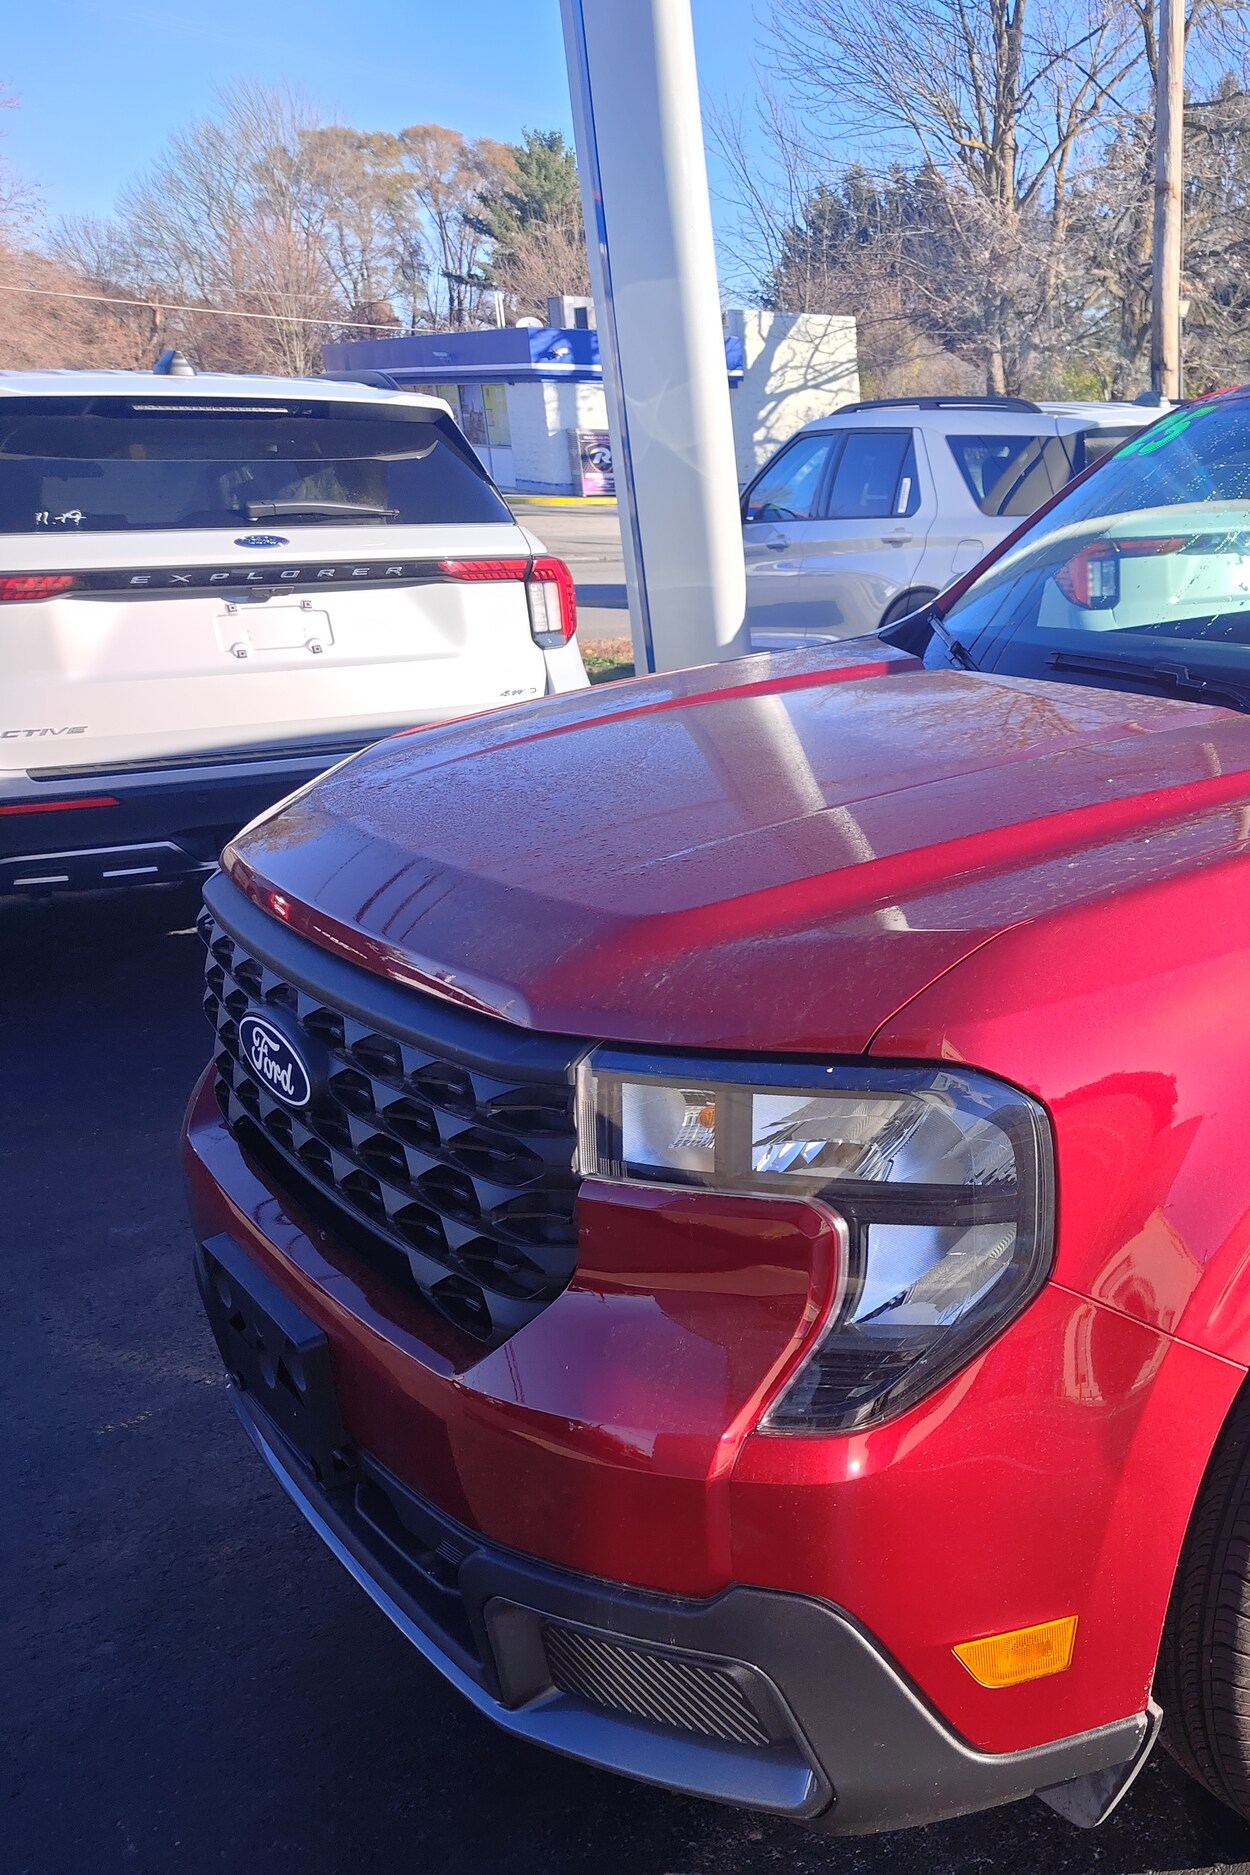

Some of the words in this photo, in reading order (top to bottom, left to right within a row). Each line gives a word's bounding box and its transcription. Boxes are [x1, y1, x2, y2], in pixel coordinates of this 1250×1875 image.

[129, 565, 403, 585] EXPLORER
[0, 725, 88, 739] CTIVE
[251, 1026, 295, 1096] Ford
